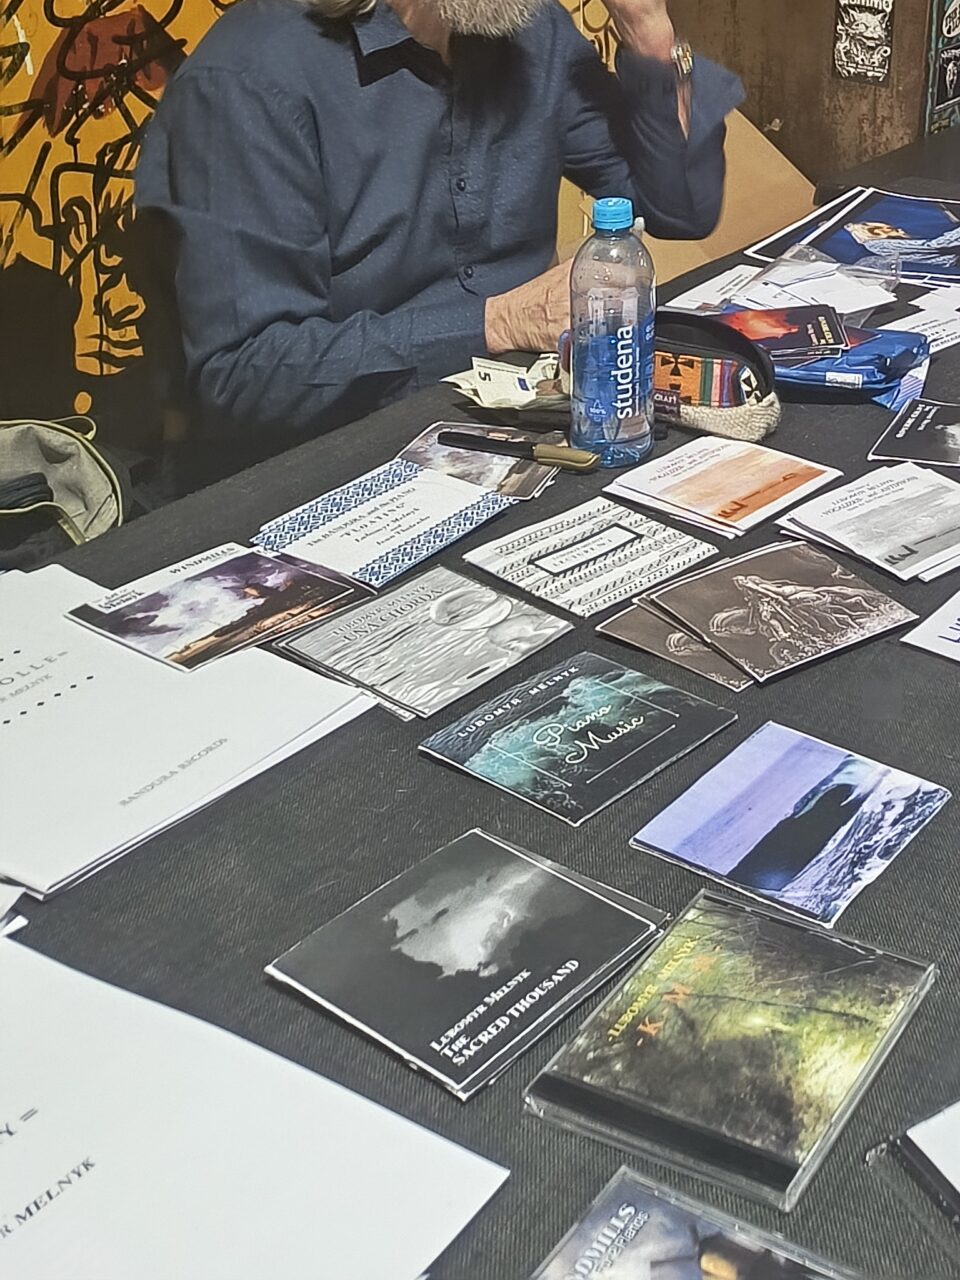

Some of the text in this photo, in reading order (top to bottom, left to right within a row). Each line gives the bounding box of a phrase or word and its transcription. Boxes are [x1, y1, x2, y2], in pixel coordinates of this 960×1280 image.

[611, 325, 633, 419] studena
[169, 547, 237, 575] WINDMILLS
[457, 664, 581, 740] LUBOMYR MELNYK
[532, 703, 613, 750] Piano
[563, 714, 646, 766] Music
[450, 957, 581, 1067] SACRED THOUSAND
[13, 1155, 97, 1227] MELNYK
[613, 1210, 650, 1249] Pianos
